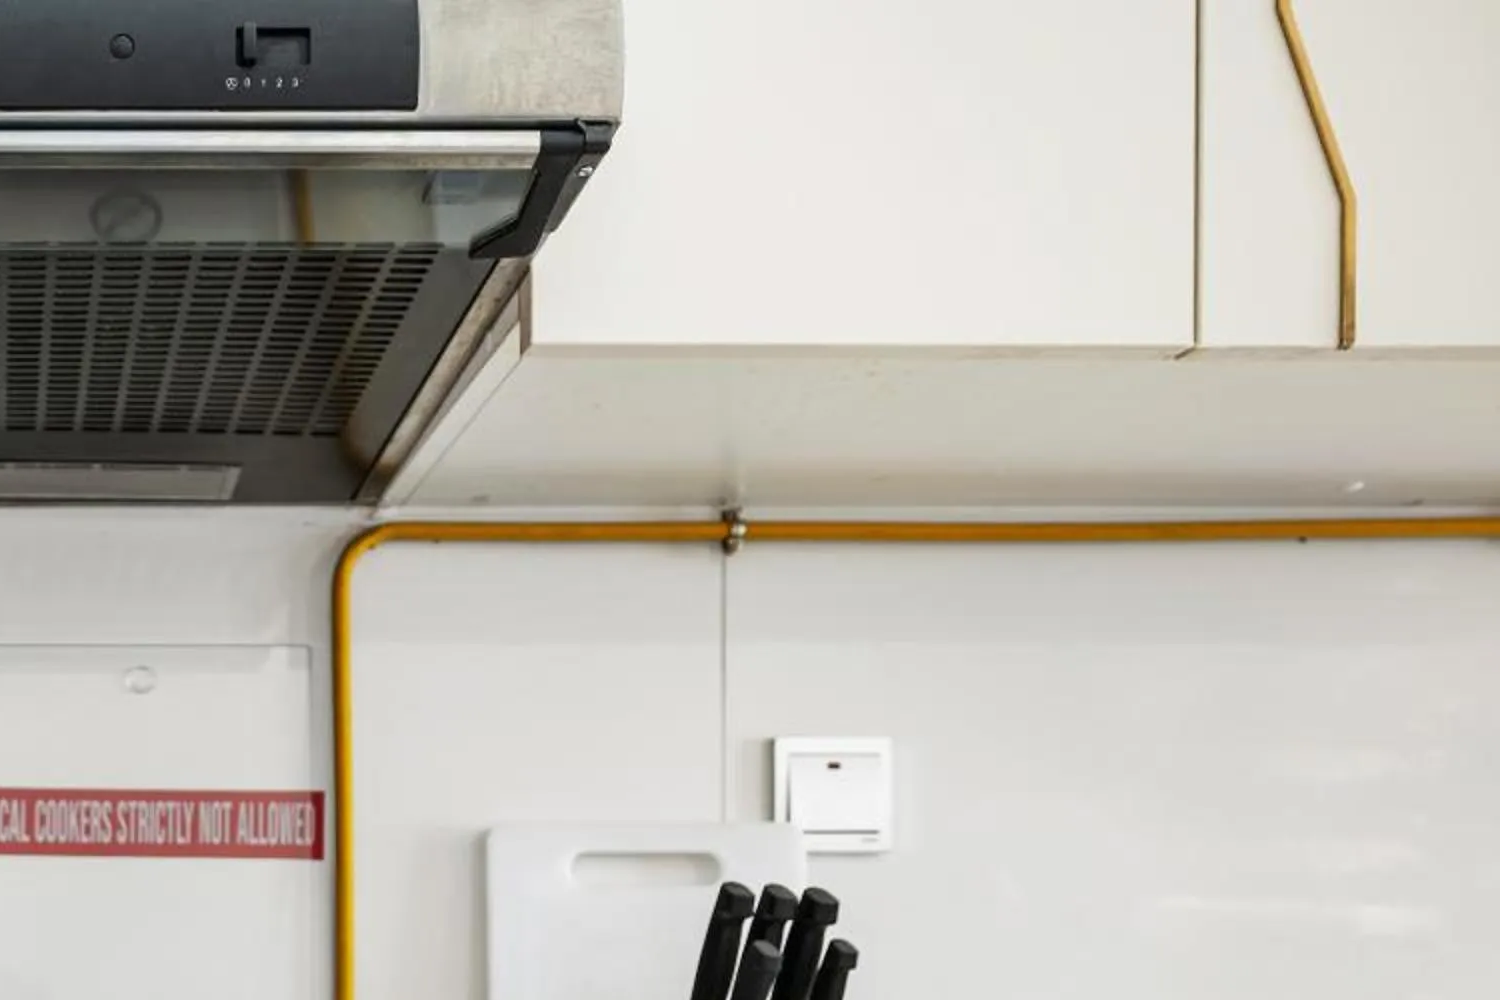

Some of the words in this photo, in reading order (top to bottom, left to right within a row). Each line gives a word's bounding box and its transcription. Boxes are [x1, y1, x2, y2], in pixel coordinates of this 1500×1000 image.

[34, 798, 112, 844] COOKERS
[115, 800, 194, 845] STRICTLY
[199, 800, 233, 845] NOT
[236, 801, 316, 847] ALLOWED
